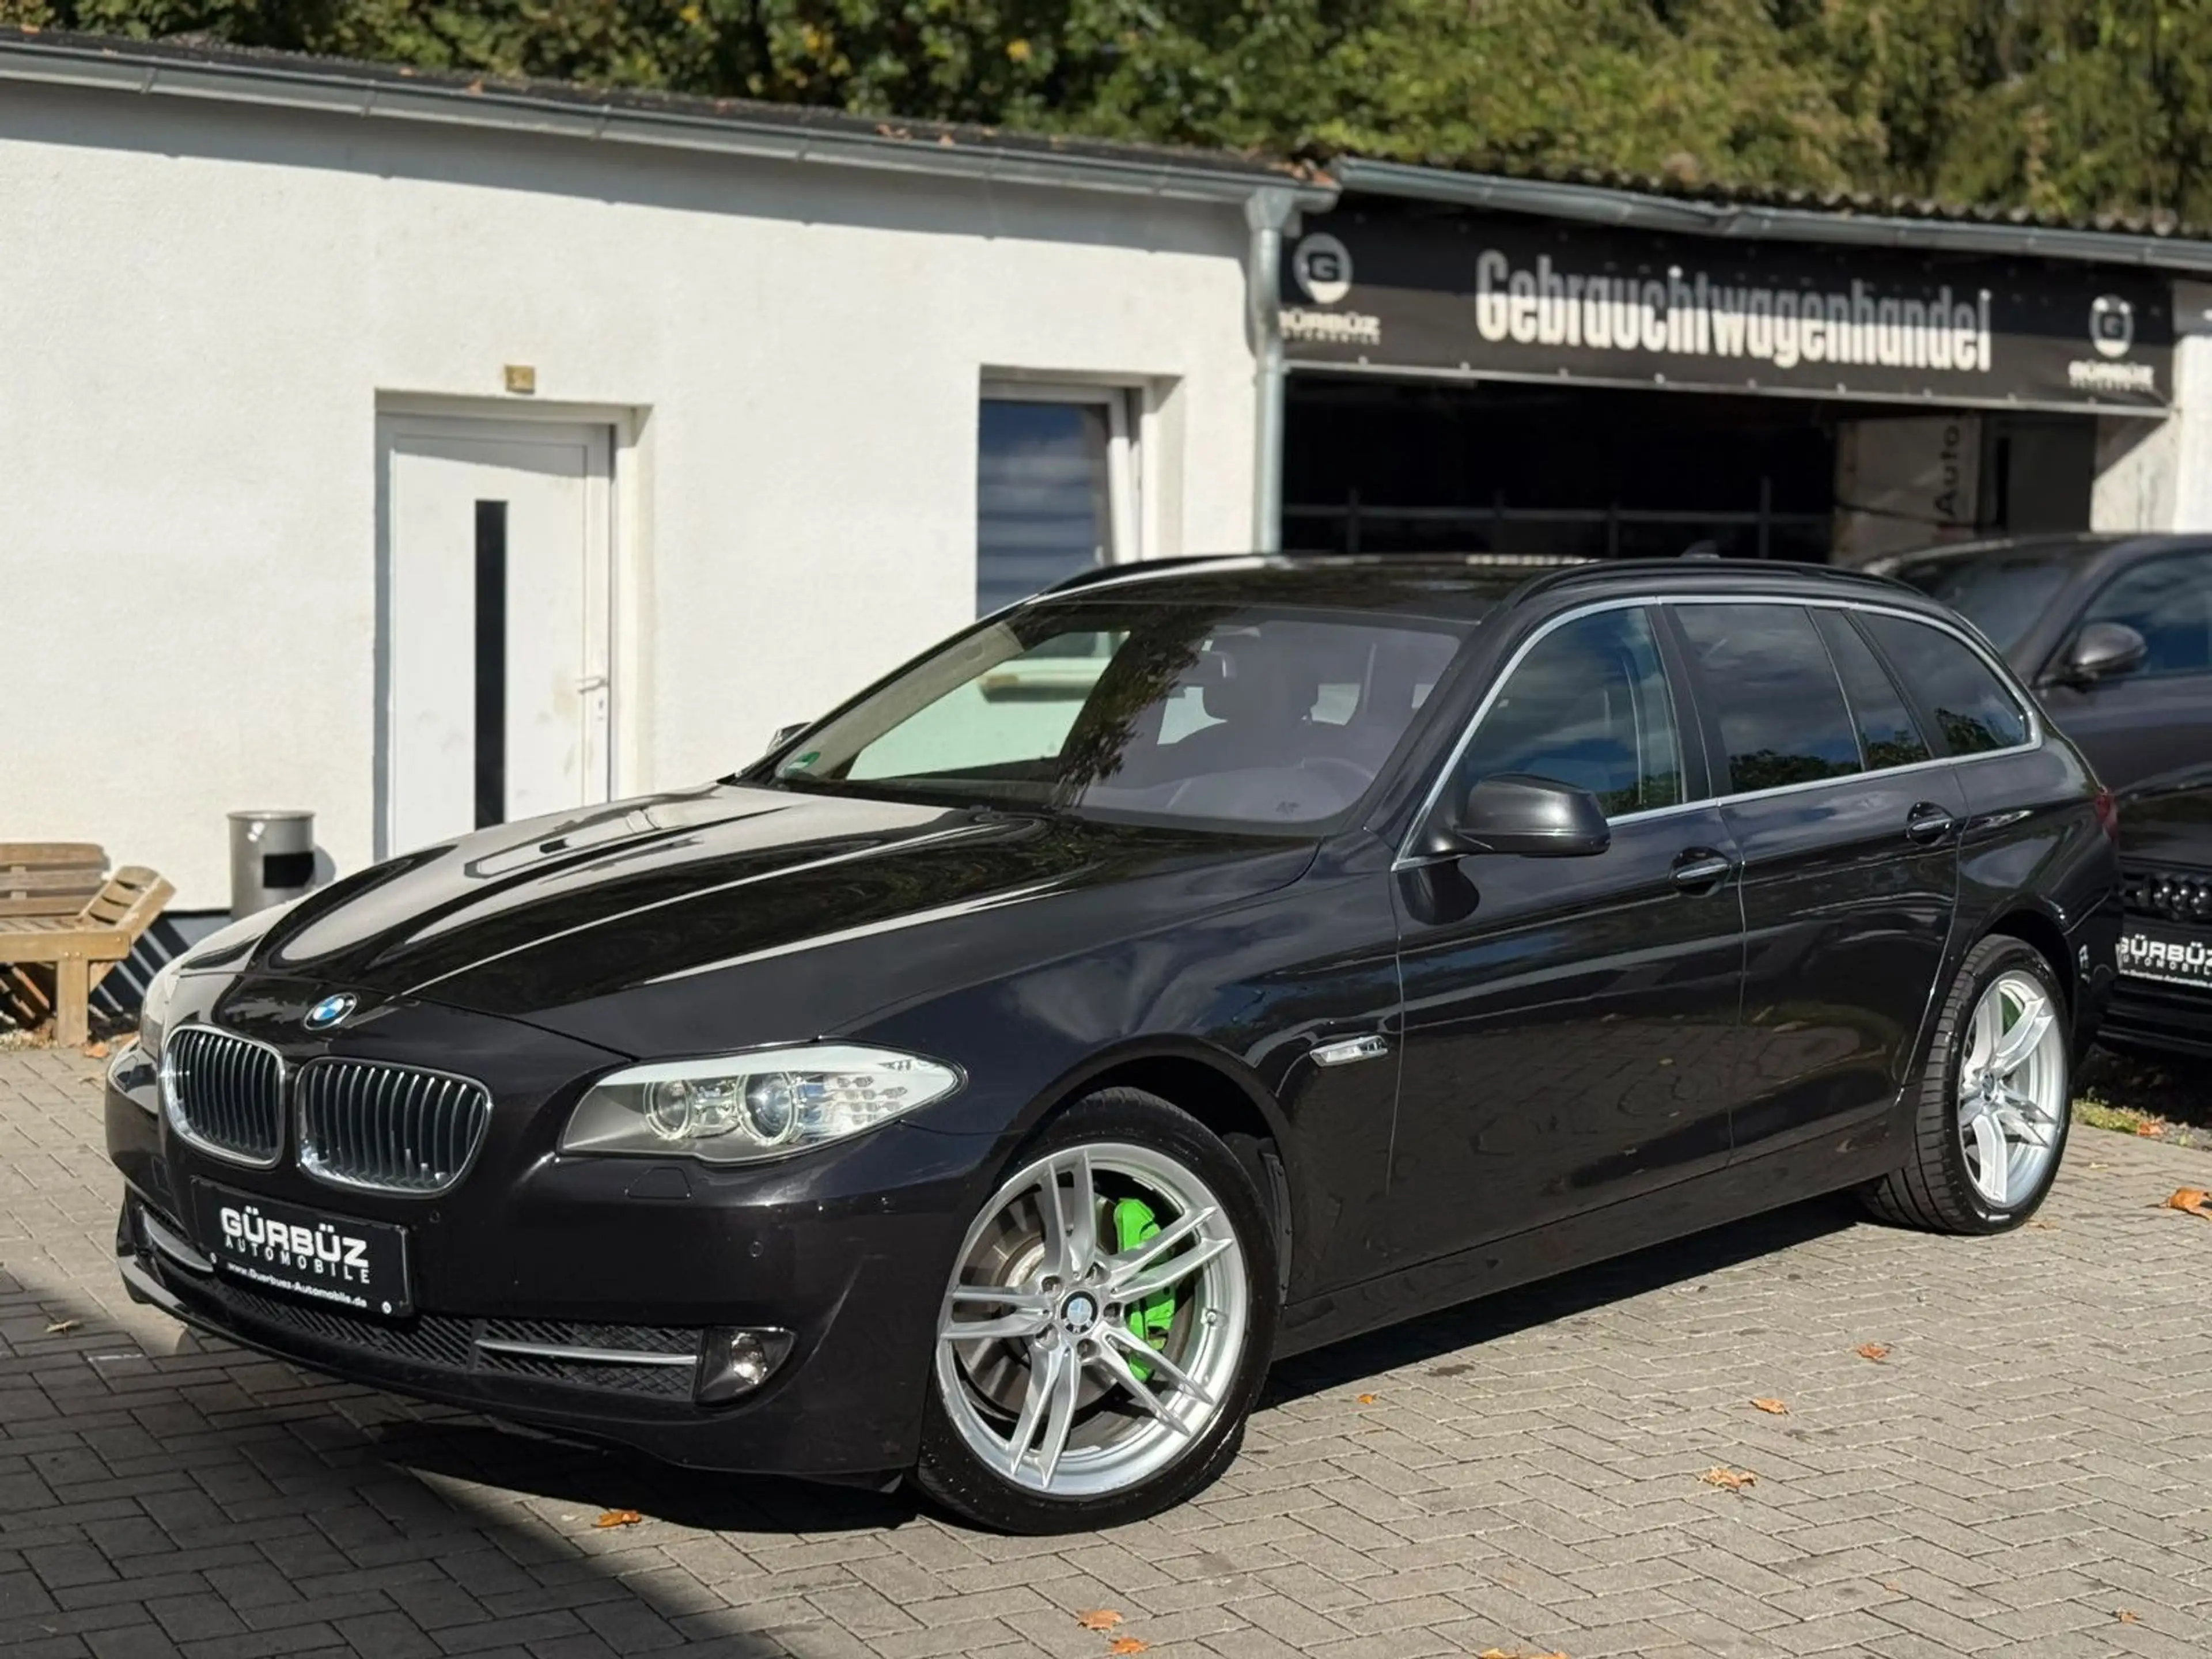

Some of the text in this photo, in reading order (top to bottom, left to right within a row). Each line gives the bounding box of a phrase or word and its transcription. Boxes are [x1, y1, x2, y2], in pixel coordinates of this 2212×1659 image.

[1476, 249, 1991, 372] Gebrauchtwagenhandel
[221, 1205, 369, 1268] GÜRBÜZ
[225, 1234, 370, 1284] AUTOMOBILE
